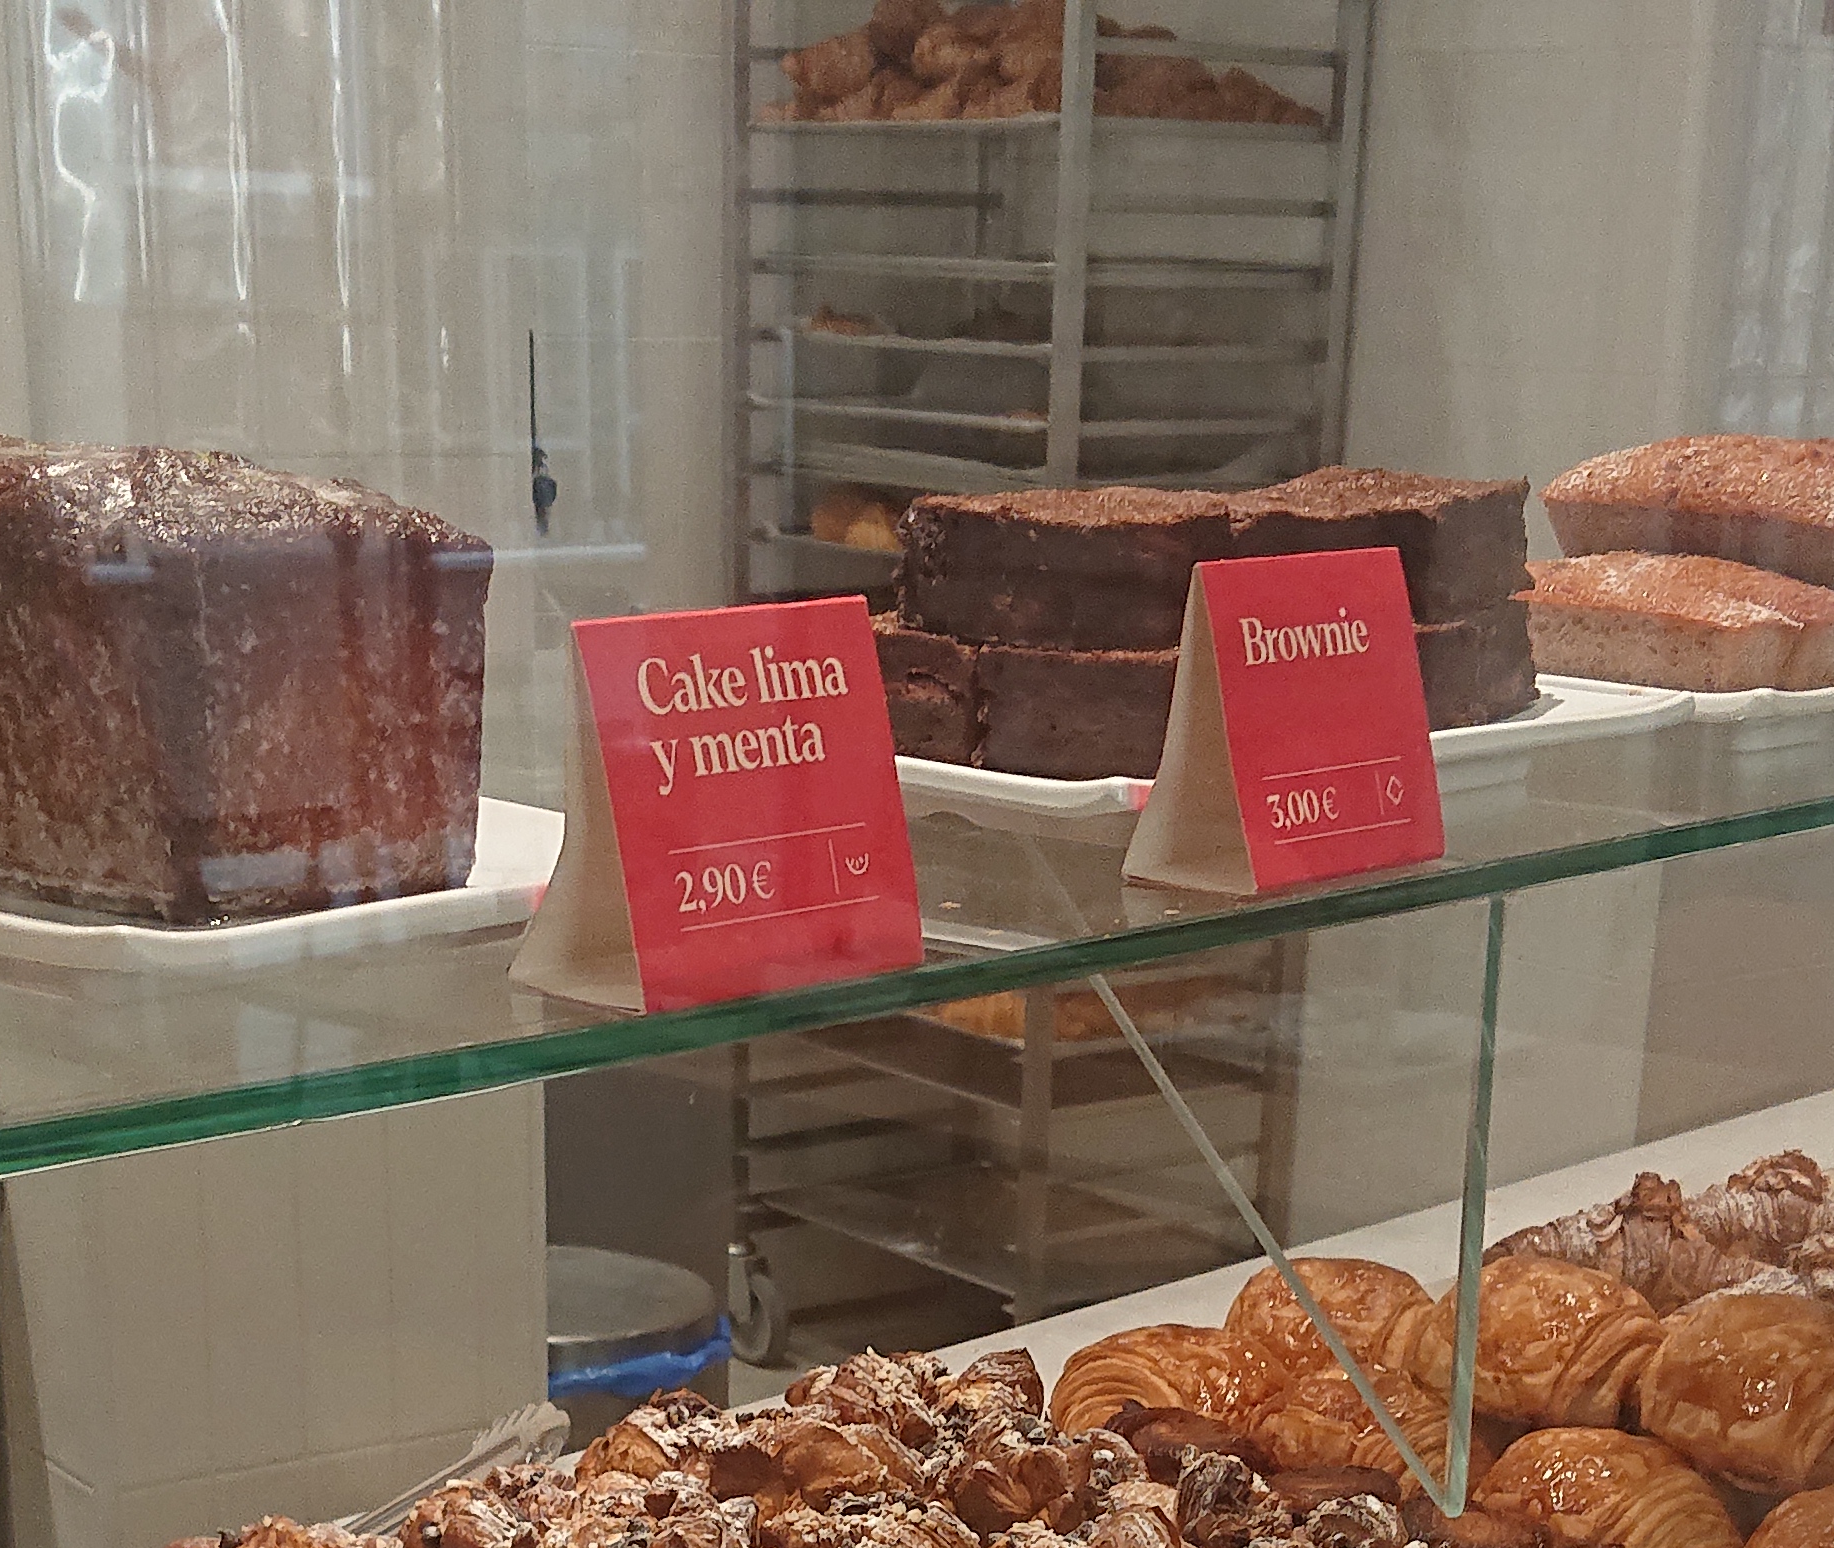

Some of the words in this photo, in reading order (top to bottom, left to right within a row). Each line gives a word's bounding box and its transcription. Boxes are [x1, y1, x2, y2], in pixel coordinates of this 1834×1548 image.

[1239, 607, 1370, 666] Brownie
[637, 653, 749, 716] Cake
[749, 645, 849, 704] lima
[649, 737, 681, 796] y
[688, 714, 827, 778] menta
